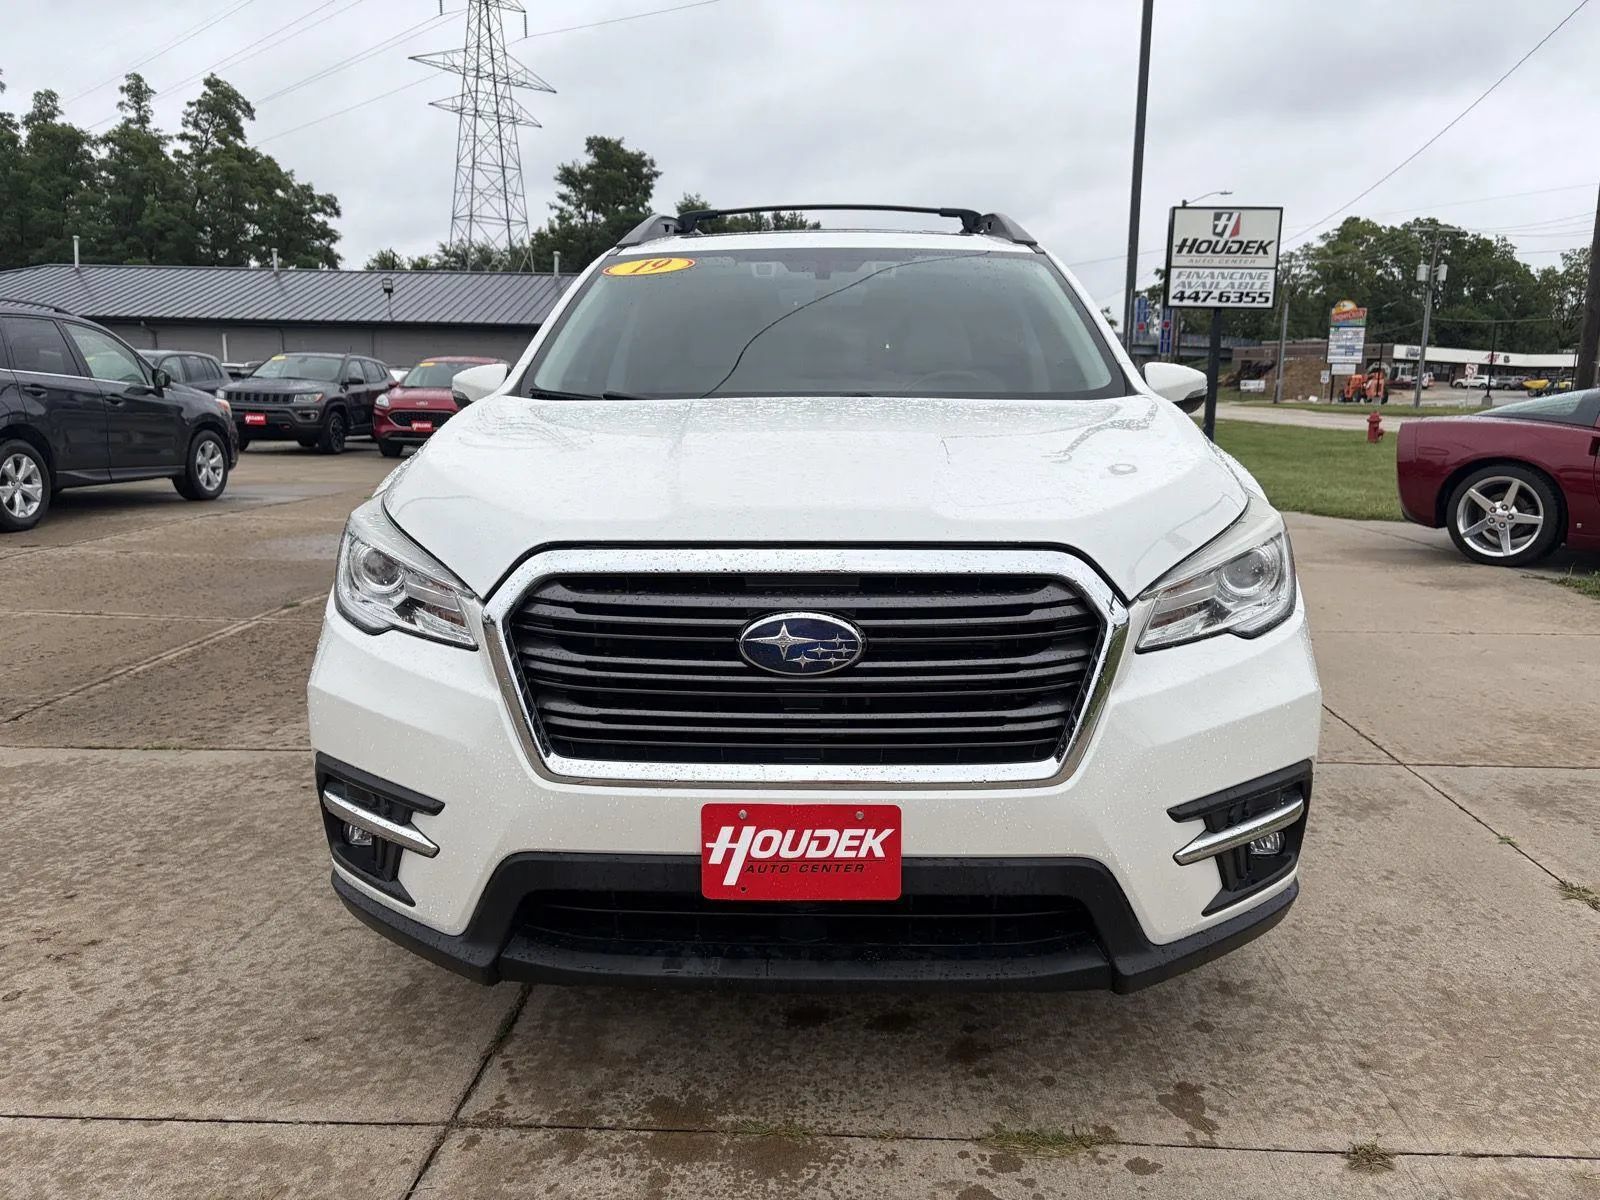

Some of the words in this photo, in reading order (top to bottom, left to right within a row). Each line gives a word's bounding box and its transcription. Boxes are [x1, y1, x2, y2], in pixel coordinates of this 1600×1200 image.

[1174, 238, 1275, 255] HOUDEK
[1176, 271, 1269, 280] FINANCING
[1175, 281, 1270, 290] AVAILABLE
[1172, 291, 1271, 304] 447-6355
[705, 826, 896, 886] HOUDEK
[745, 864, 790, 874] AUTO
[799, 863, 866, 873] CENTER
